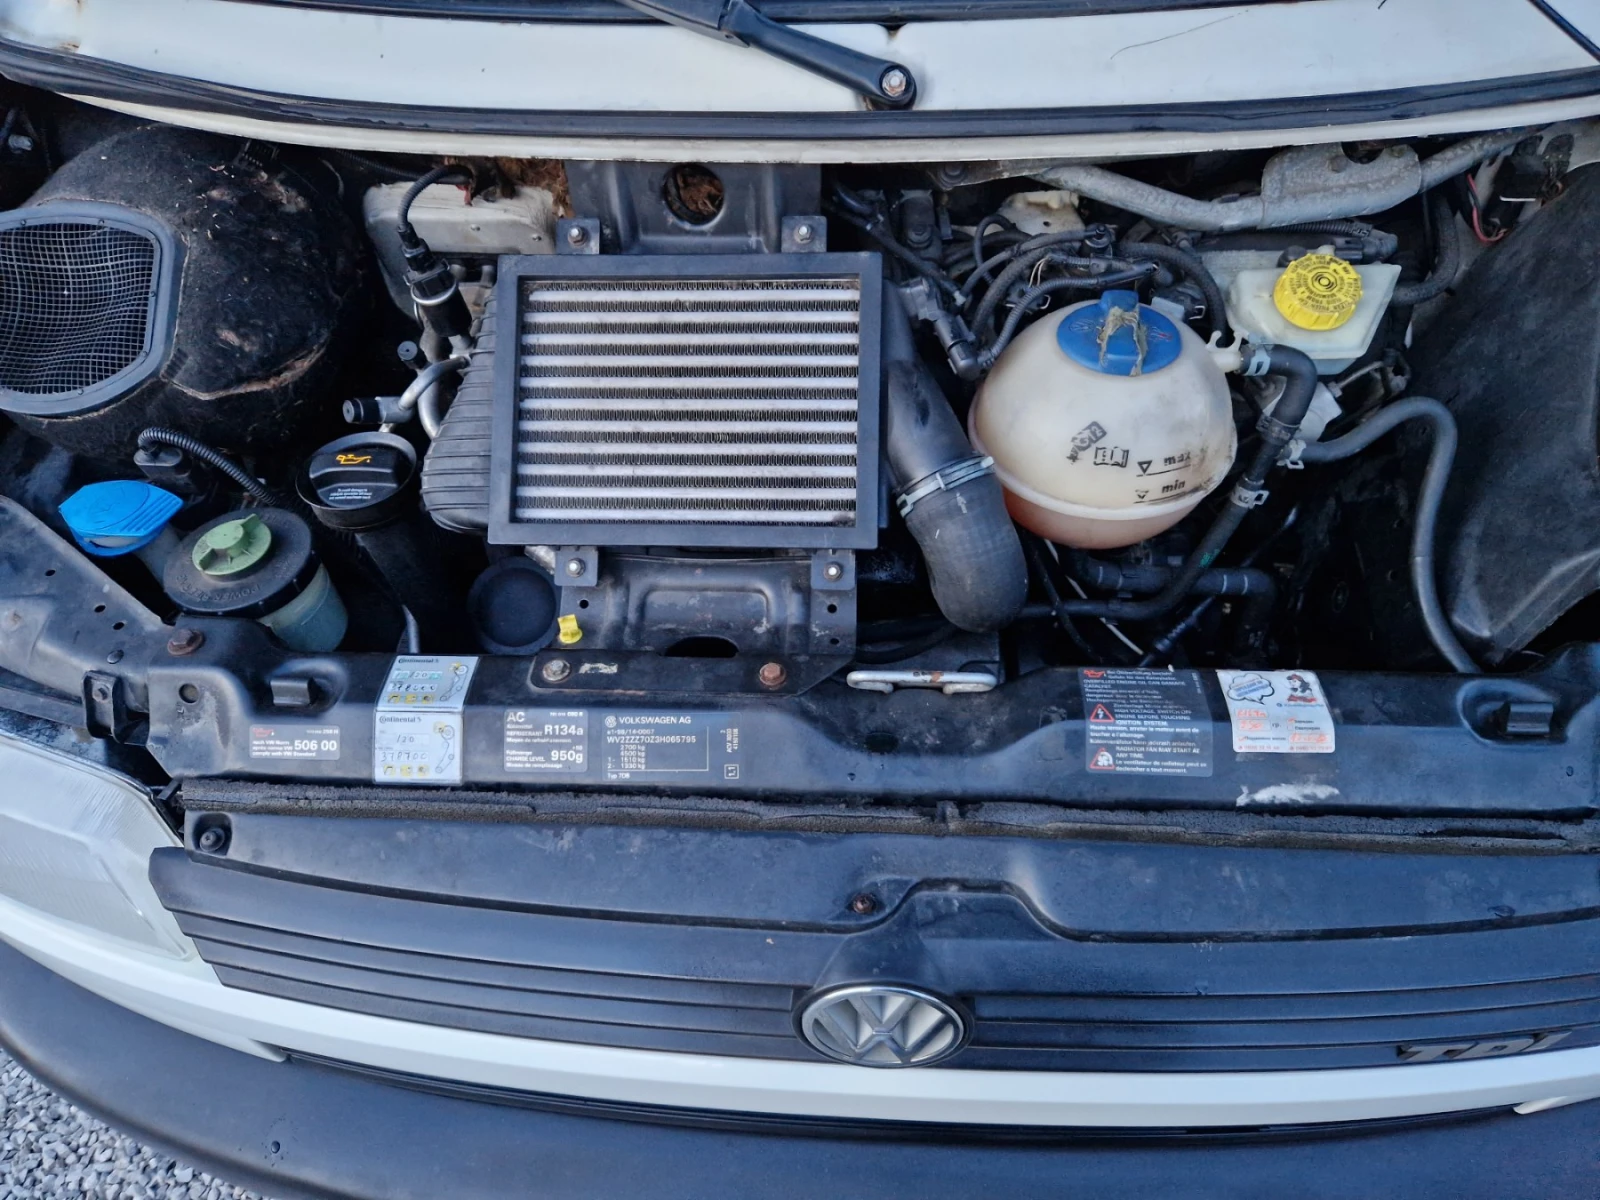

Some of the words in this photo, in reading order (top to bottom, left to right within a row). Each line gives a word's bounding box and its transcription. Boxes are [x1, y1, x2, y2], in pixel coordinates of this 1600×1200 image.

[1162, 480, 1185, 493] min
[507, 712, 525, 722] AC
[545, 725, 583, 735] R134a
[294, 740, 318, 750] 506
[321, 740, 337, 751] 00
[551, 750, 583, 763] 950g
